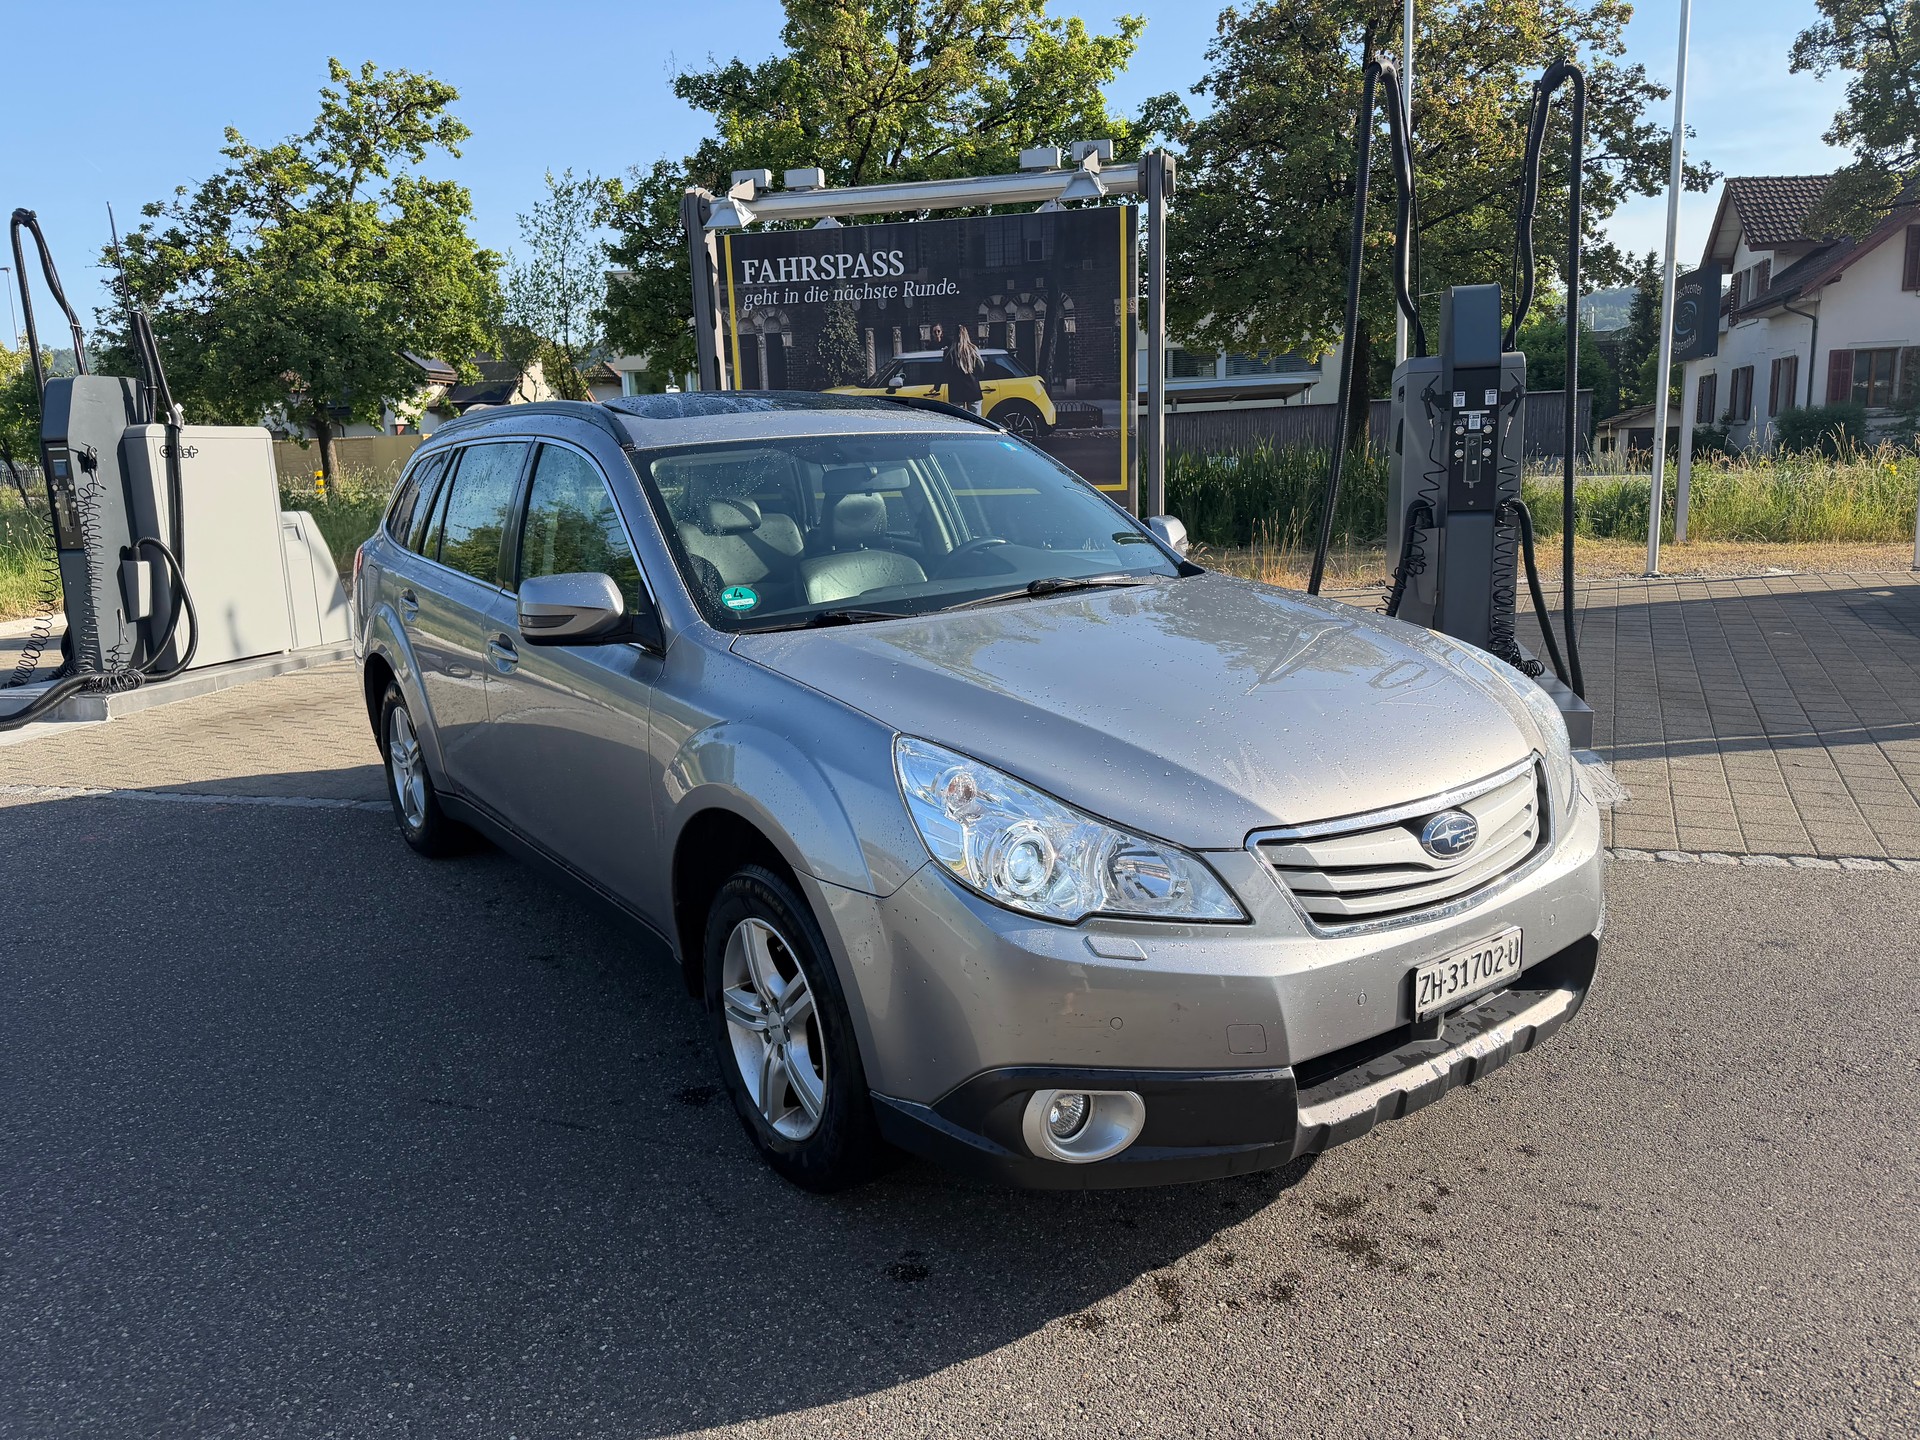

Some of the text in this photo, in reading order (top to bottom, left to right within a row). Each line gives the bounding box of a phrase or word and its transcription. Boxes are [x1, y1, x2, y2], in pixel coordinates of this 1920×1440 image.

[741, 250, 905, 285] FAHRSPASS
[743, 277, 961, 311] geht in die nächste Runde.
[1675, 282, 1703, 301] aschcenter
[733, 587, 744, 599] 4
